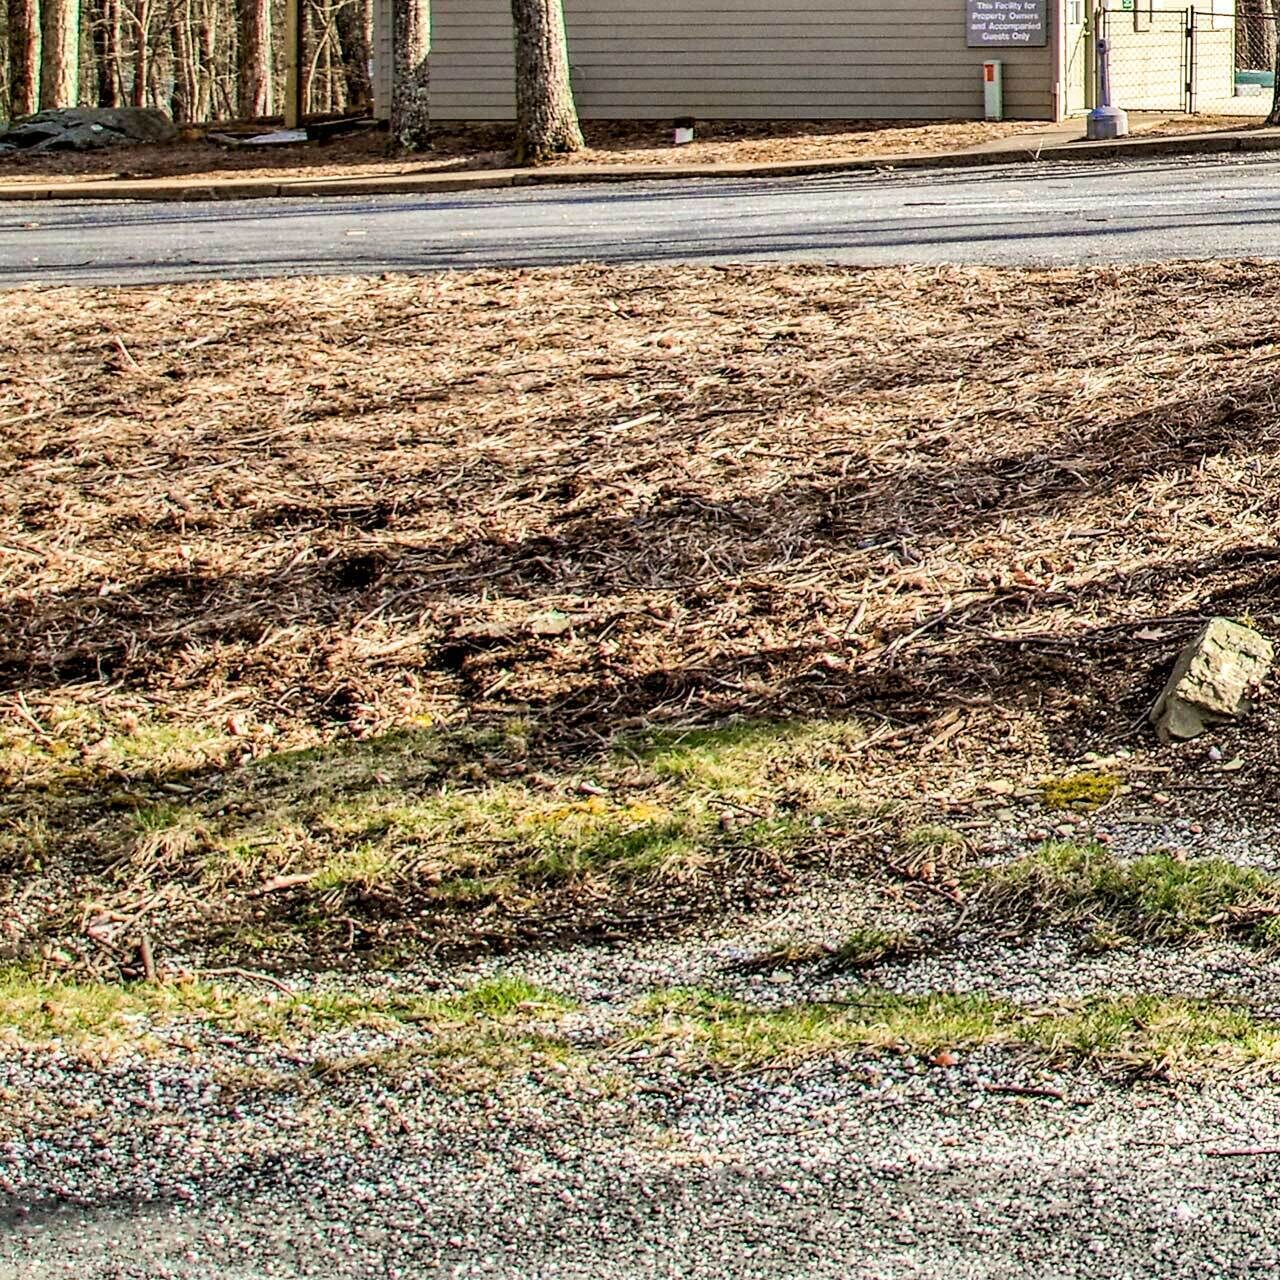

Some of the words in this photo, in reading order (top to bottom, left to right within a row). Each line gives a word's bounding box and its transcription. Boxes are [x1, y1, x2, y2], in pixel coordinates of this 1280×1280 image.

[995, 2, 1022, 10] Facility
[972, 13, 1006, 21] Property
[1009, 12, 1039, 20] Owners
[989, 22, 1041, 31] Accompanied
[982, 32, 1010, 40] Guests
[1012, 32, 1030, 41] Only
